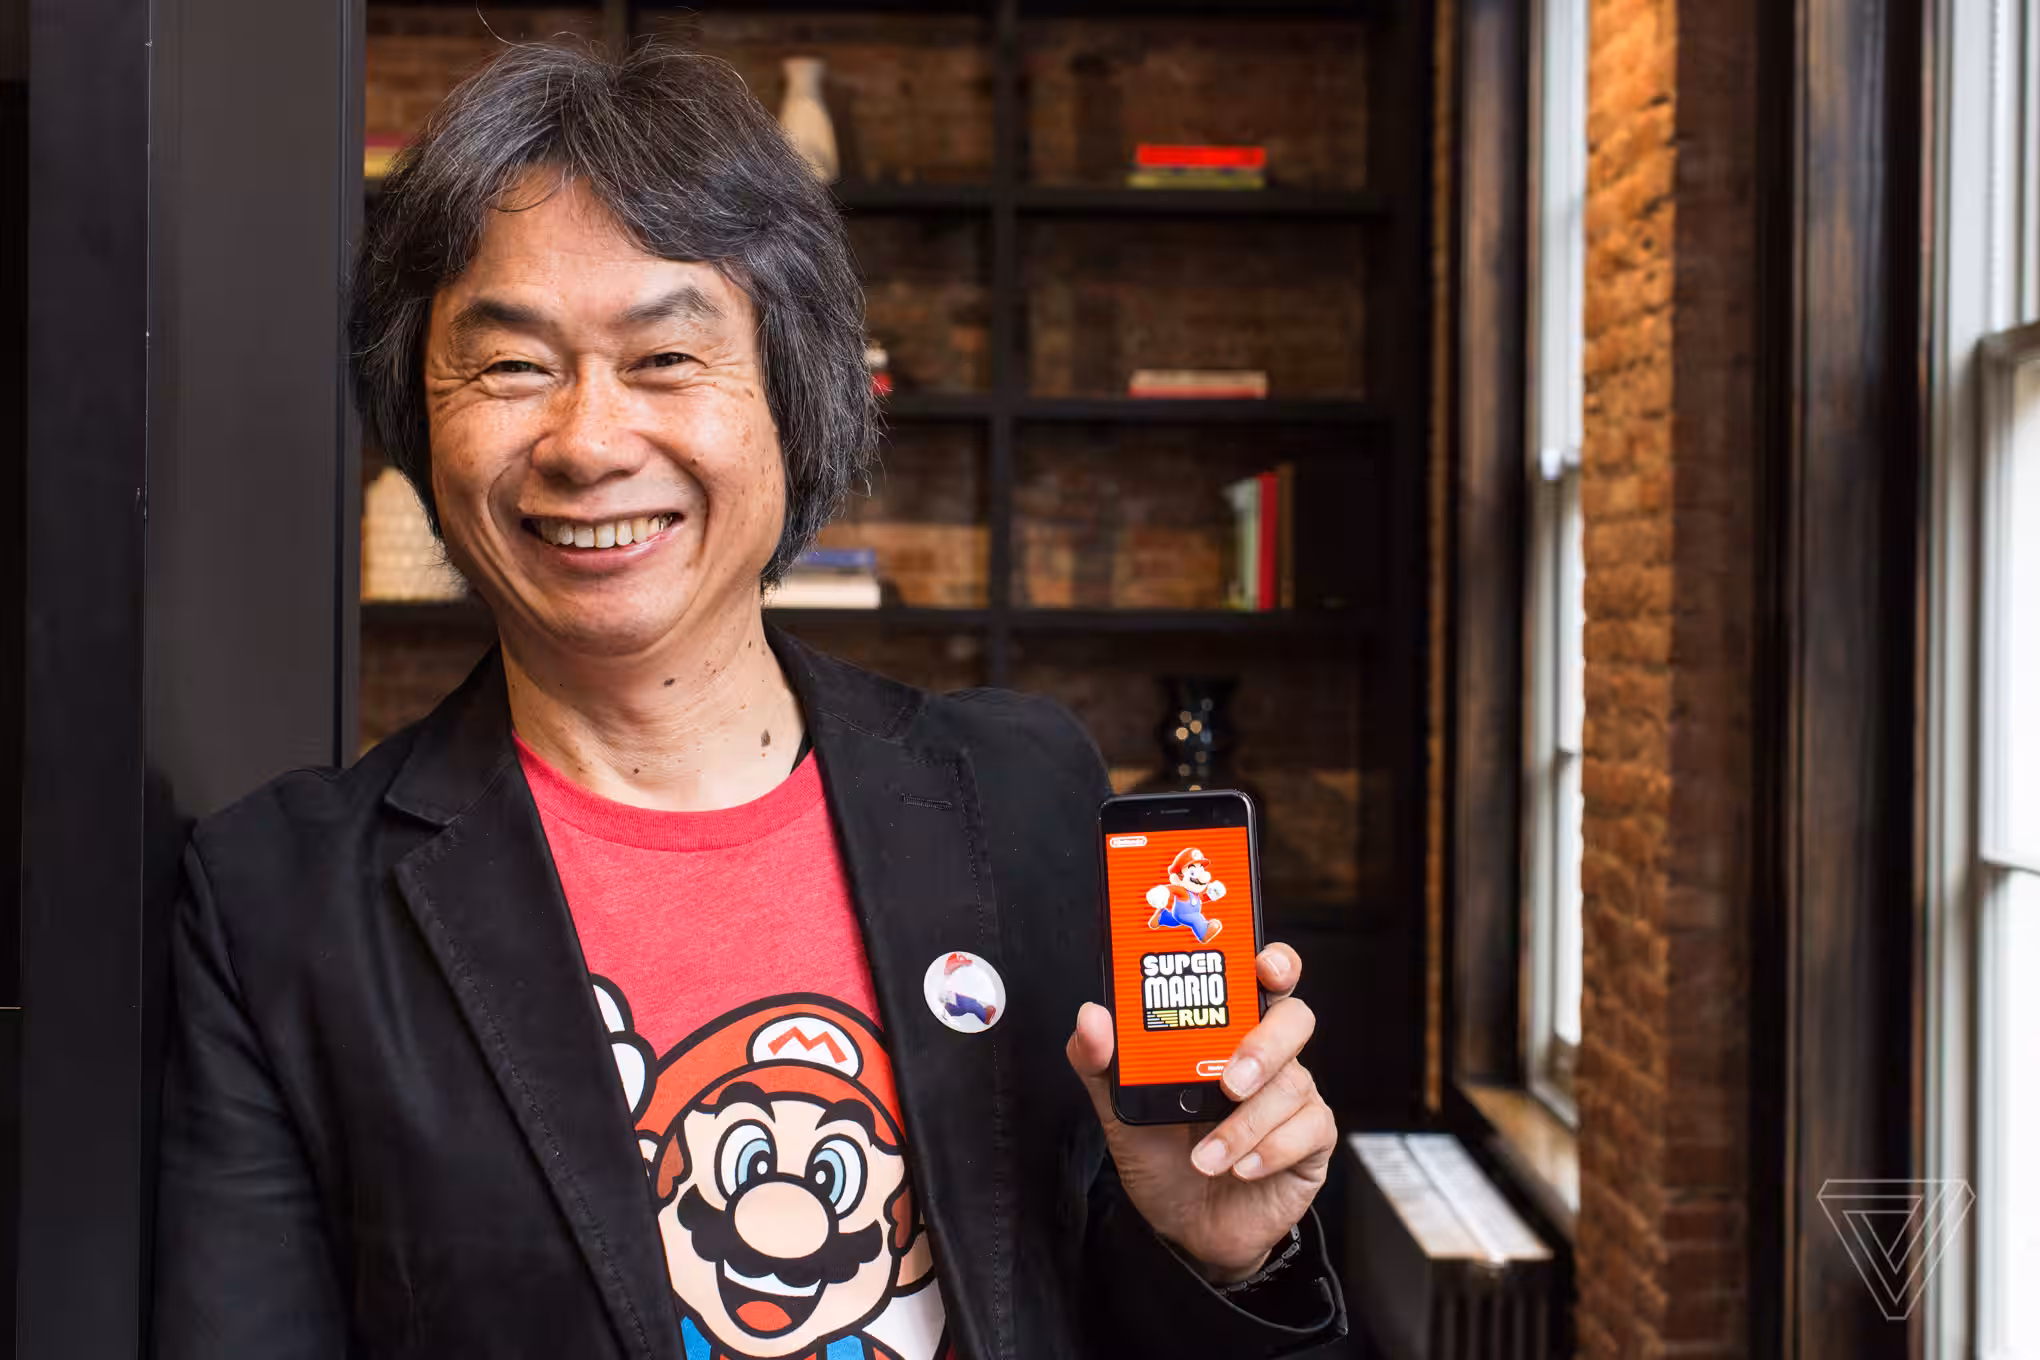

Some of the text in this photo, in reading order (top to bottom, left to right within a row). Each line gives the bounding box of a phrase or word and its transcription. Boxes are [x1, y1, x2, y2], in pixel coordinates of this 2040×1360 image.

[1143, 952, 1223, 976] SUPER
[1144, 973, 1225, 1009] MARIO
[1178, 1007, 1226, 1027] RUN
[767, 1026, 848, 1064] M
